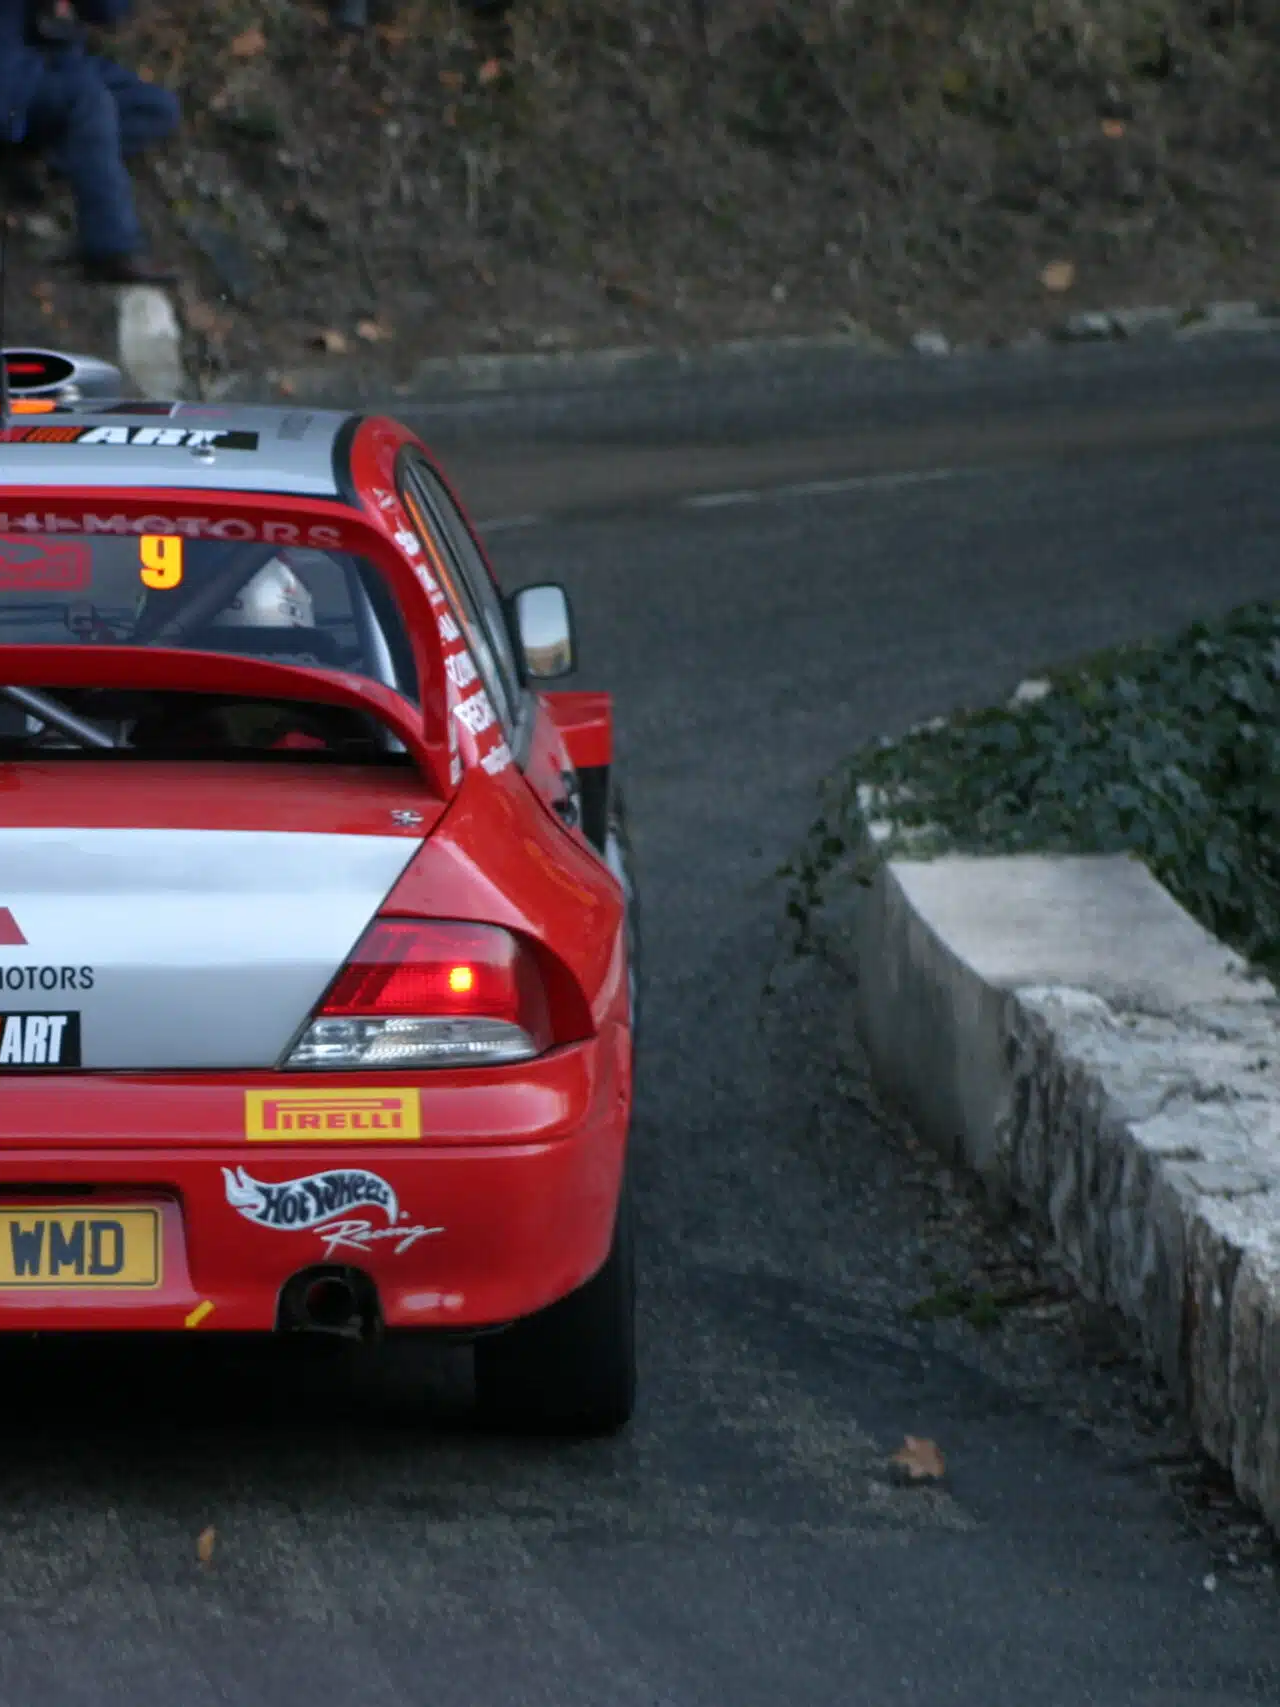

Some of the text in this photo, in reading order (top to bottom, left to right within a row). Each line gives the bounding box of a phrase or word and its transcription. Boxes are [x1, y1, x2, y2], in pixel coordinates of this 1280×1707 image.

[81, 513, 343, 548] MOTORS
[140, 535, 183, 590] 9
[263, 1098, 403, 1130] PIRELLI
[9, 1220, 125, 1276] WMD
[313, 1219, 446, 1260] Racing
